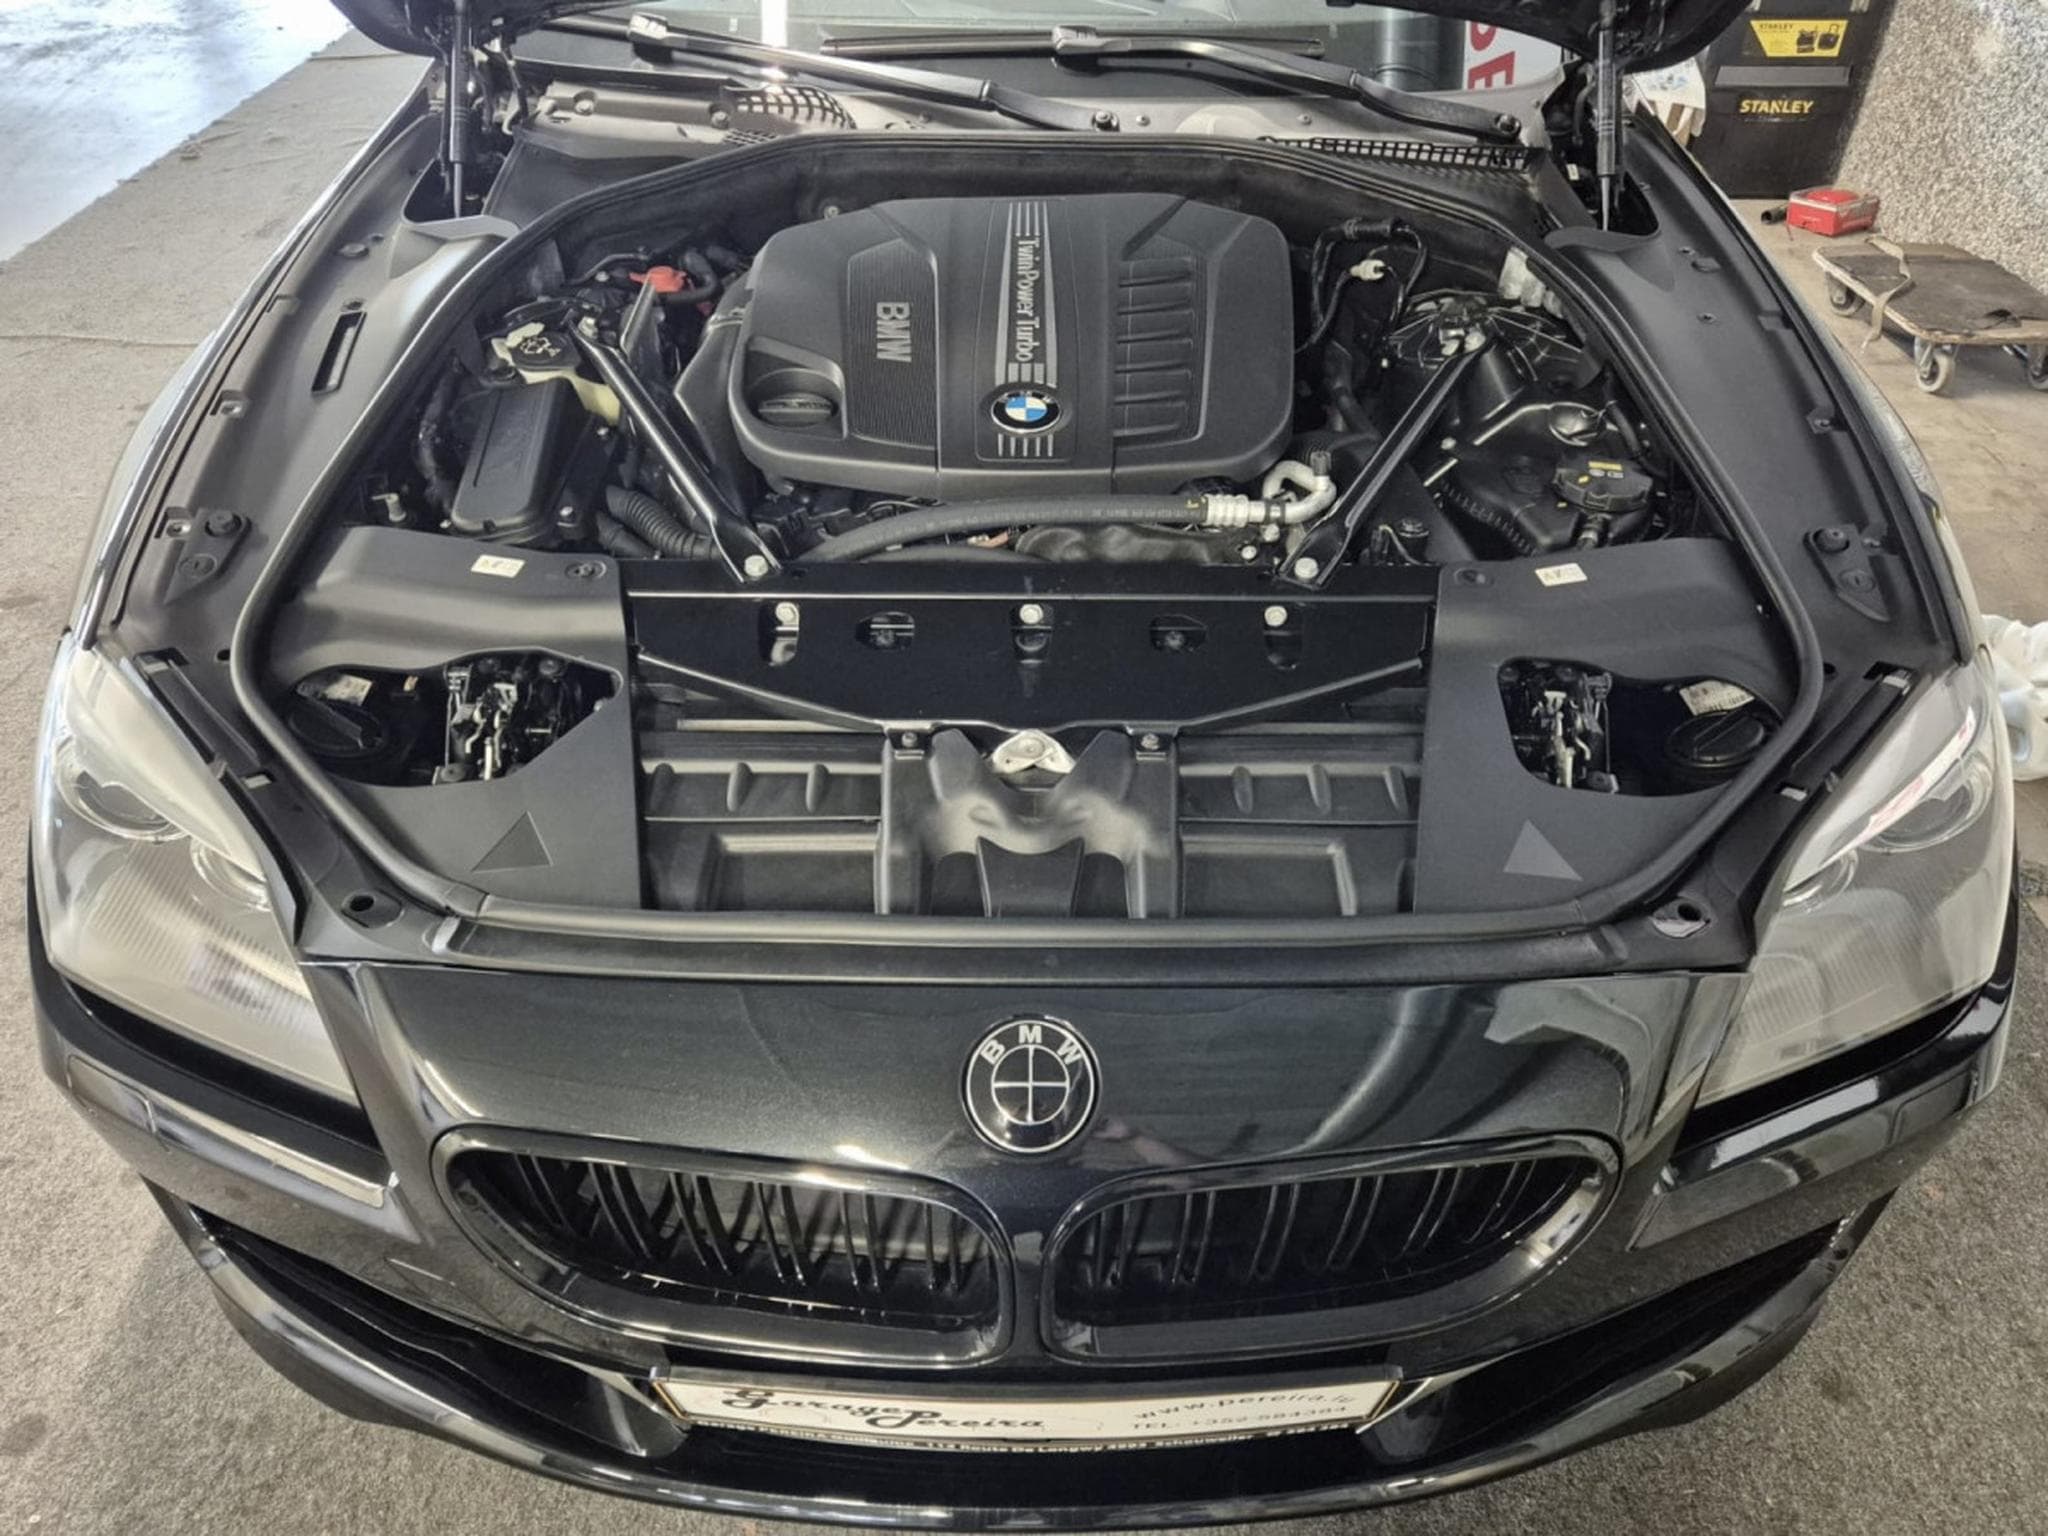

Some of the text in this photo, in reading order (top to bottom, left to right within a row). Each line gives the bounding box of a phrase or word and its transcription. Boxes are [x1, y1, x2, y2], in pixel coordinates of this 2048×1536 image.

[1740, 99, 1814, 114] STANLEY
[1015, 236, 1040, 362] TwinPower Turbo
[876, 302, 912, 362] BMW
[979, 1024, 1083, 1065] BMW
[722, 1387, 900, 1417] Garage
[865, 1409, 1044, 1429] Pereira
